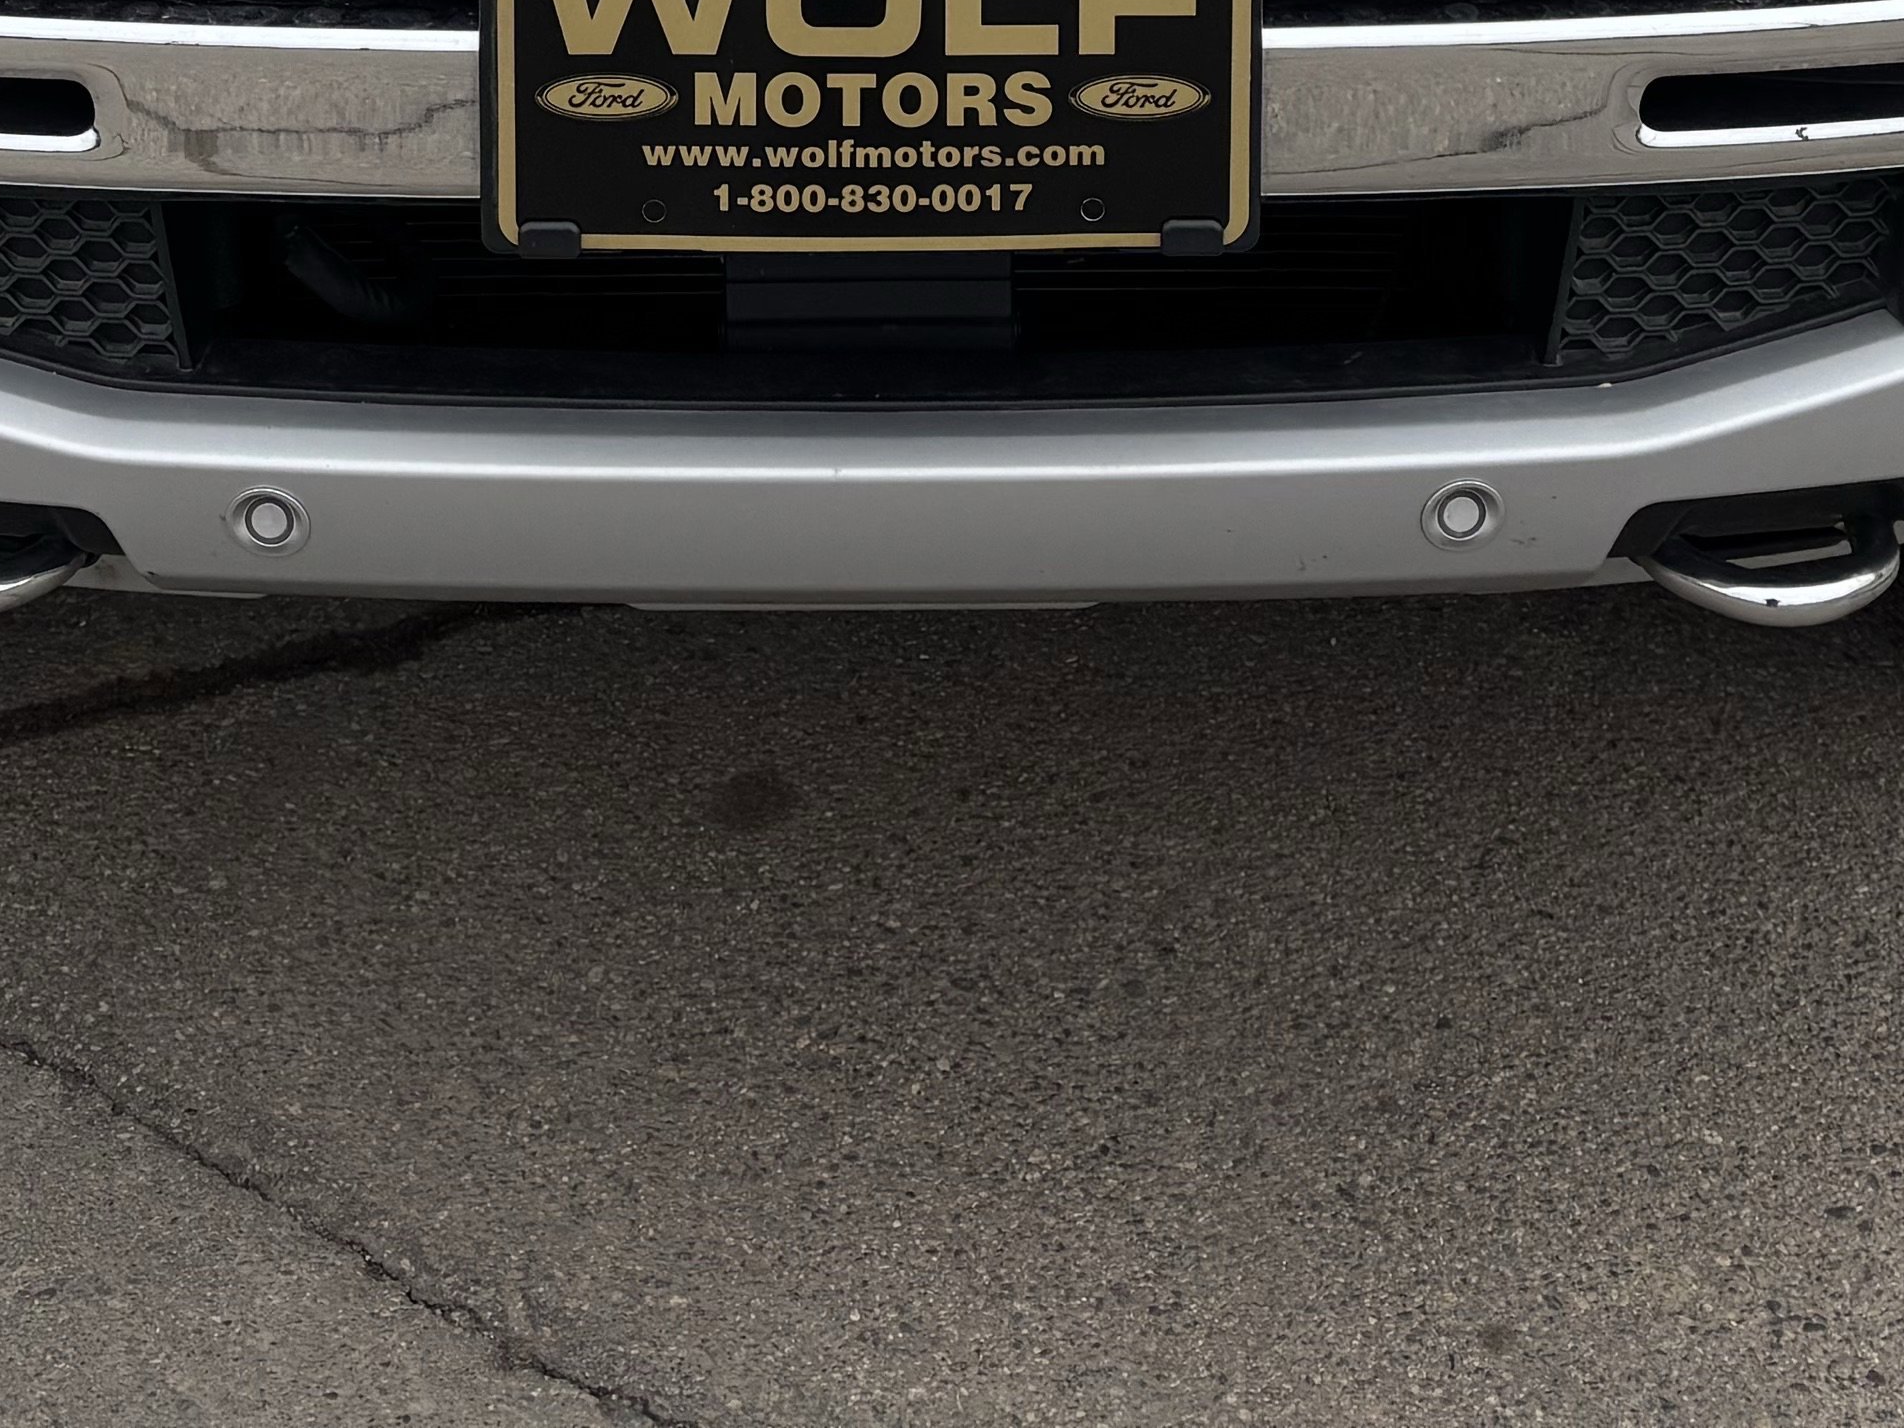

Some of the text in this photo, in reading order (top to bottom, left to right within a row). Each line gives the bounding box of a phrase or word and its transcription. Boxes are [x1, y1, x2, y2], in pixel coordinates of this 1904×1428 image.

[568, 81, 645, 108] Ford
[695, 71, 1054, 127] MOTORS
[1100, 81, 1178, 108] Ford
[642, 139, 1106, 169] www.wolfmotors.com
[713, 183, 1034, 213] 1-800-830-0017
